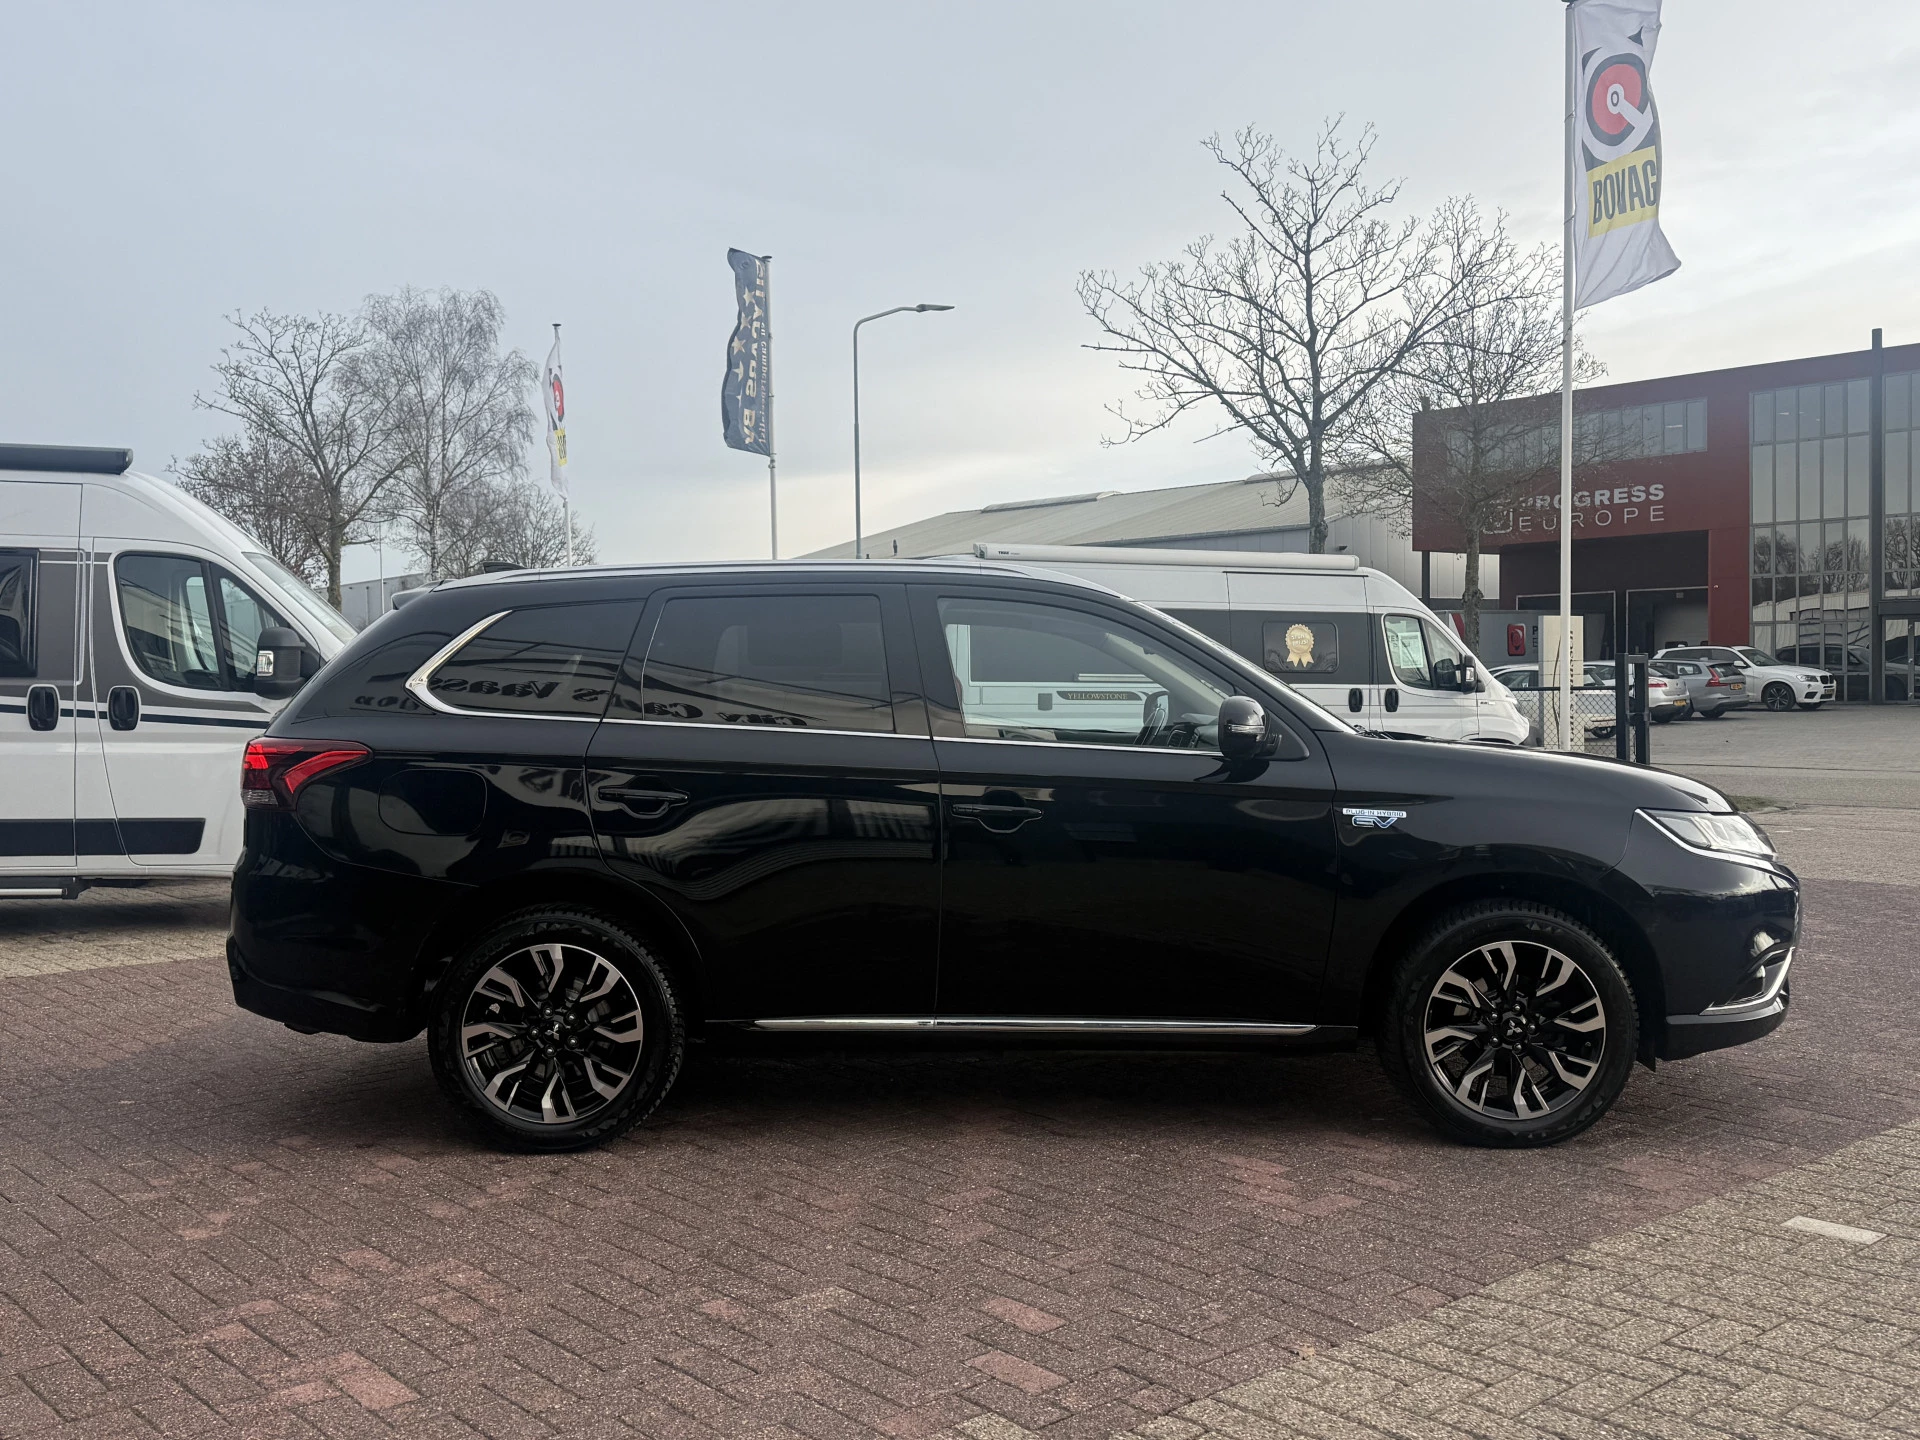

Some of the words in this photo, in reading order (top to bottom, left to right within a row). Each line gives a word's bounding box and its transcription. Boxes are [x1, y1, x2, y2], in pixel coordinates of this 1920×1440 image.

[1592, 159, 1658, 225] BOVAG
[1519, 505, 1665, 532] EUROPE
[1067, 692, 1129, 700] YELLOWSTONE
[1352, 815, 1398, 829] EV
